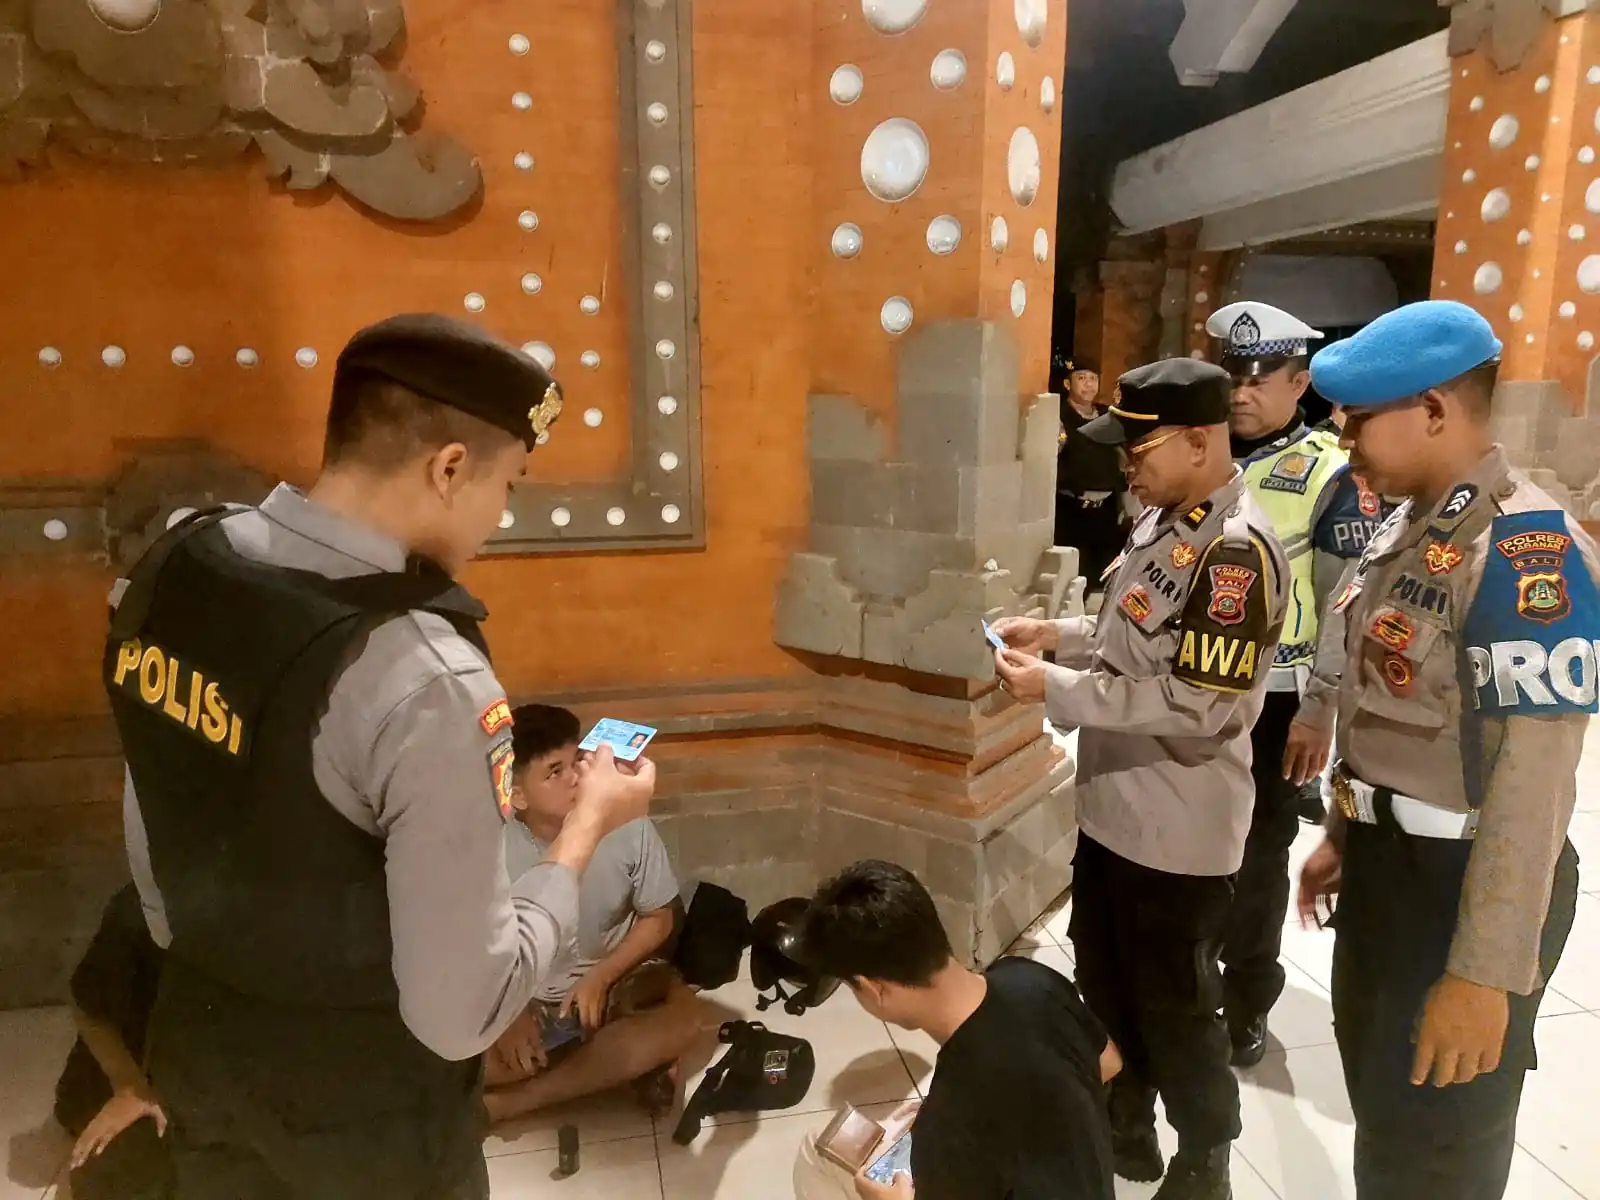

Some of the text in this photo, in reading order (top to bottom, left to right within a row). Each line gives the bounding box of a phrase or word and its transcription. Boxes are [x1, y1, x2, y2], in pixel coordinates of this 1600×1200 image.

[1502, 534, 1565, 550] POLRES
[1516, 557, 1559, 568] BALI
[1142, 560, 1182, 603] POLRI
[1217, 579, 1245, 589] BALI
[1176, 630, 1264, 681] AWA
[1465, 636, 1600, 710] PRO
[114, 637, 242, 755] POLISI
